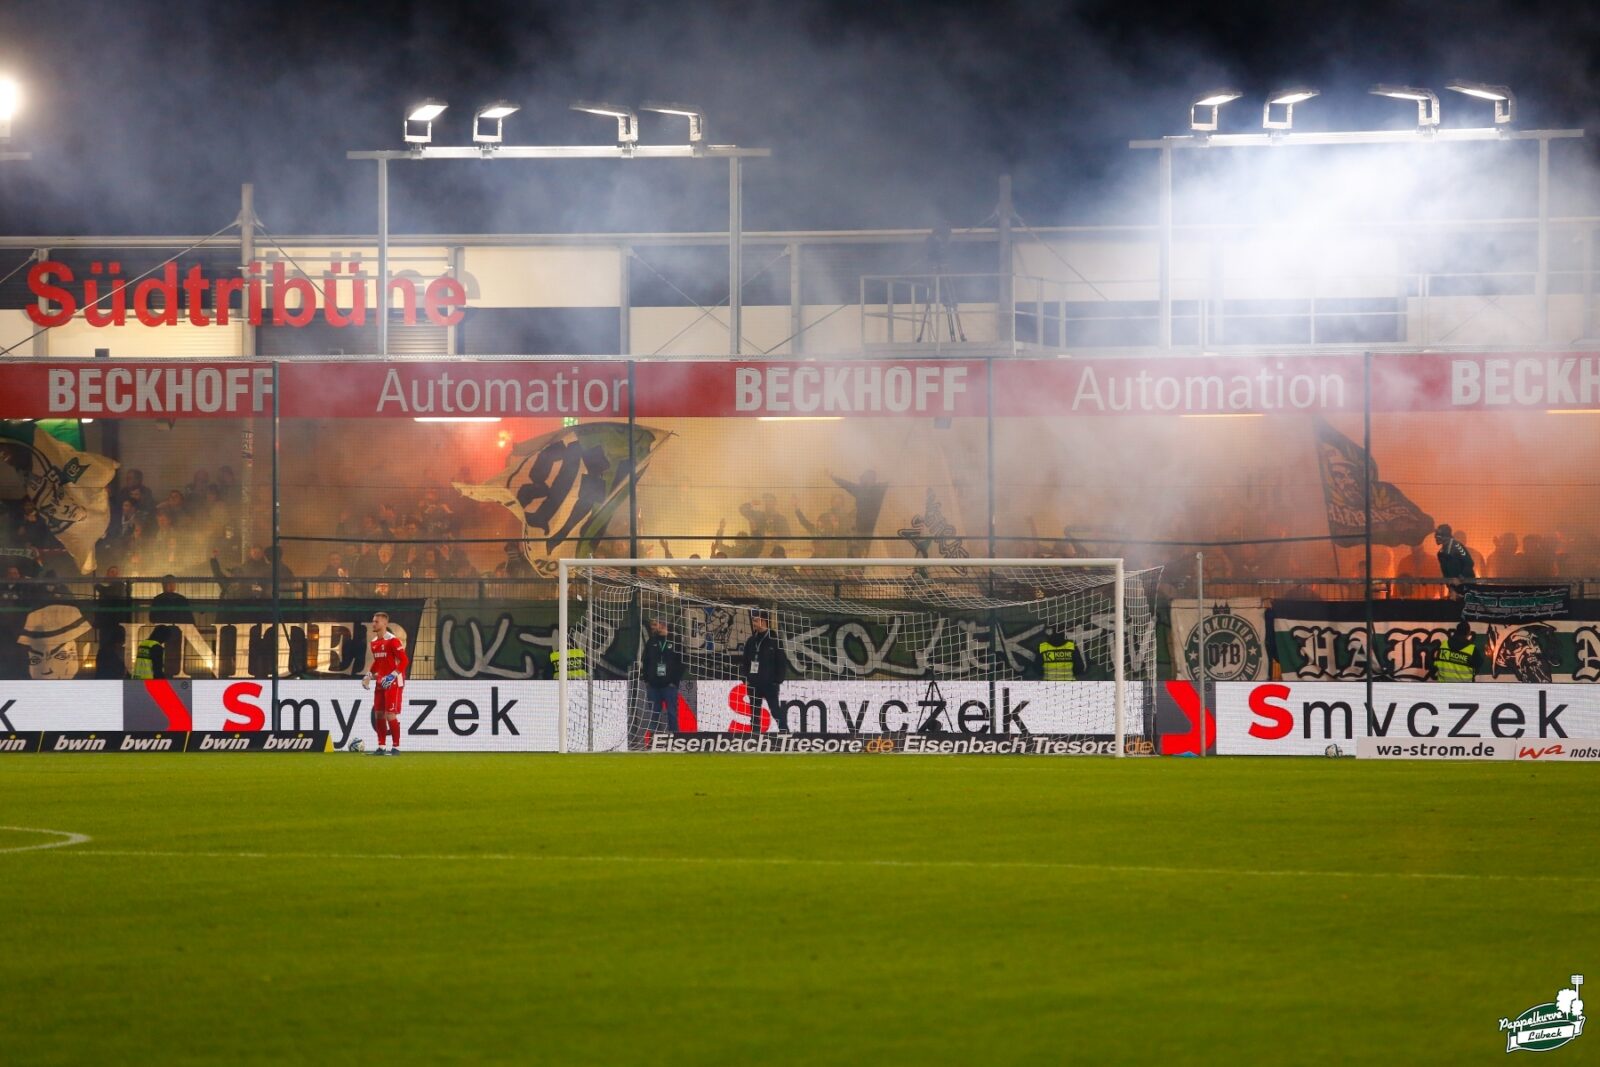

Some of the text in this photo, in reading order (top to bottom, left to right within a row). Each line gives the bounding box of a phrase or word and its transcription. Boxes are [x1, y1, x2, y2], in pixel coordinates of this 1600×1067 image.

[25, 260, 467, 328] Südtribüne
[48, 367, 276, 413] BECKHOFF
[735, 366, 967, 412] BECKHOFF
[1071, 361, 1345, 411] Automation
[1451, 357, 1600, 406] BECKH
[54, 733, 172, 751] bwin bwin
[200, 733, 313, 751] bwin bwin
[651, 734, 771, 752] Eisenbach
[903, 735, 1025, 754] Eisenbach
[1376, 742, 1495, 757] wa-strom.de
[1519, 744, 1566, 759] wa
